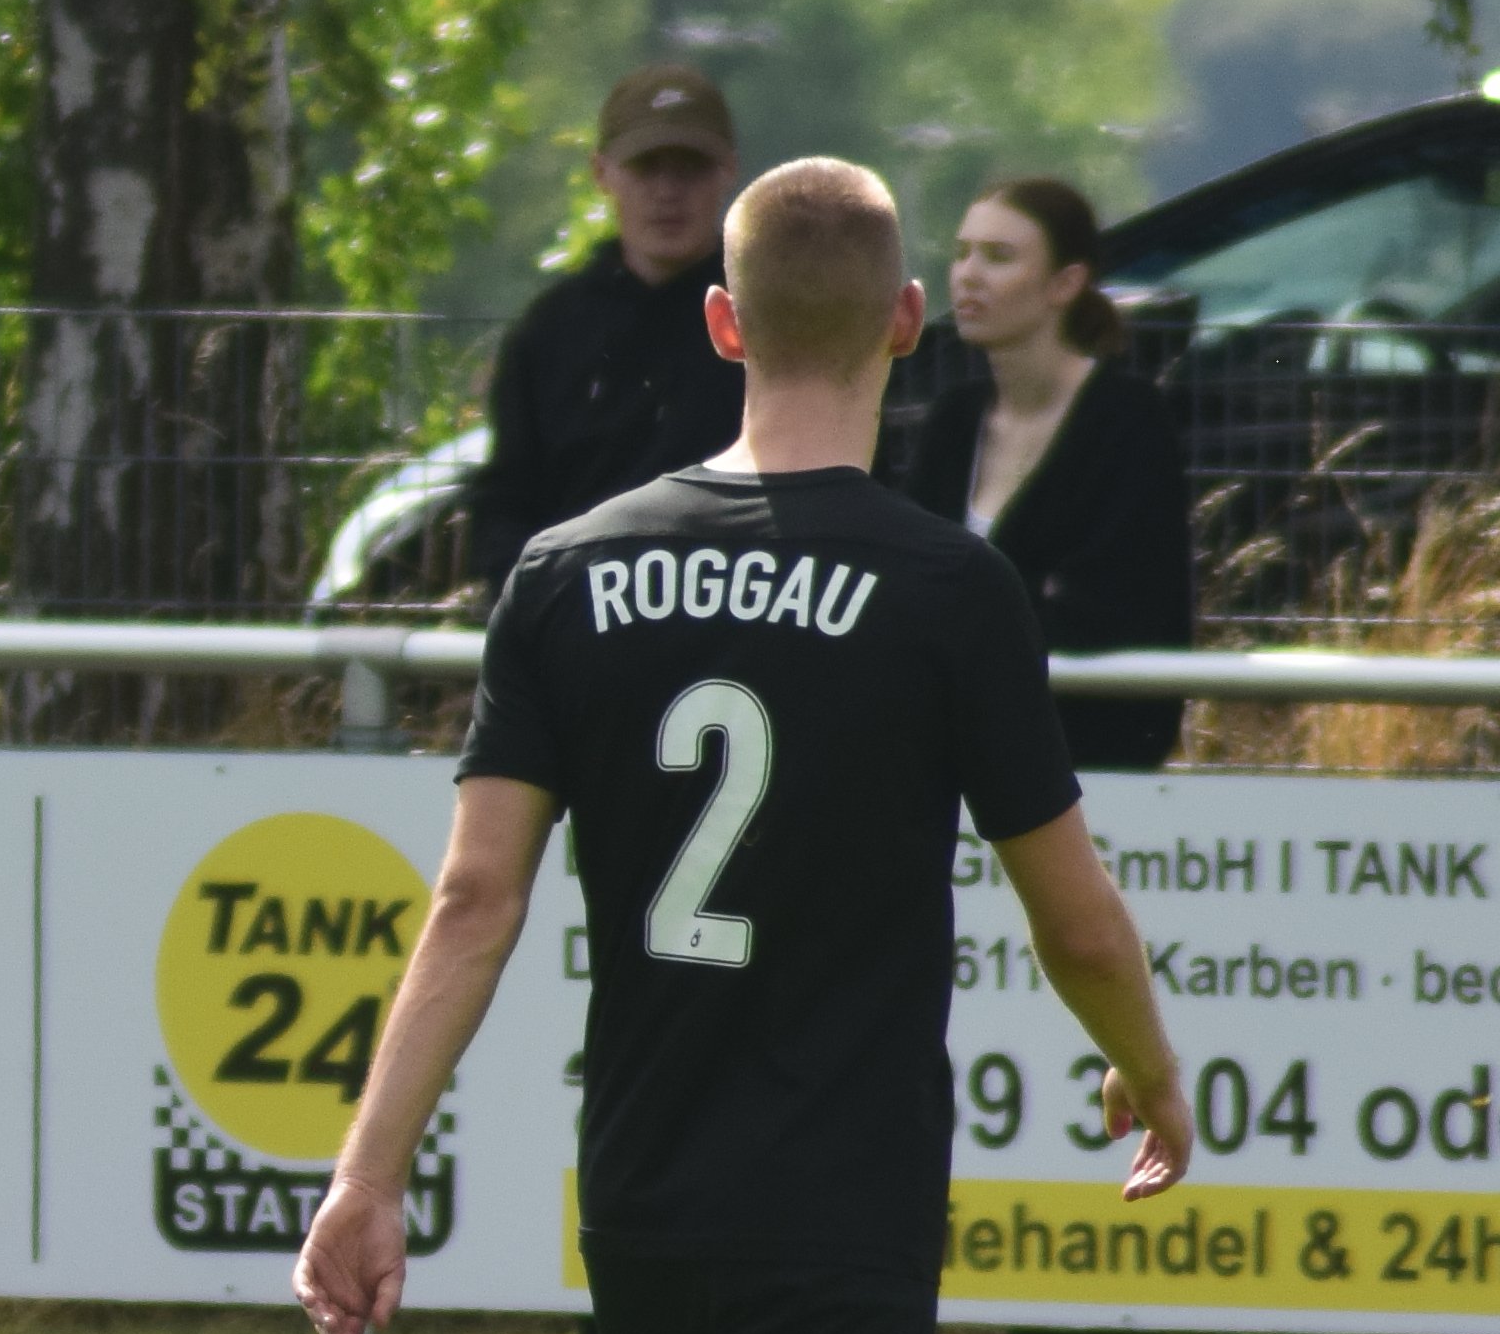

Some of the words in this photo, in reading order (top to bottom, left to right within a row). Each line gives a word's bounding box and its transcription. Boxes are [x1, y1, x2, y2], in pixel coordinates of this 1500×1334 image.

[588, 548, 879, 636] ROGGAU
[645, 679, 772, 967] 2
[1090, 834, 1257, 892] mbH
[1315, 839, 1489, 899] TANK
[200, 881, 412, 957] TANK
[1144, 942, 1358, 1000] Karben
[212, 972, 382, 1105] 24
[1357, 1064, 1491, 1160] od
[174, 1183, 433, 1235] STATN
[950, 1201, 1267, 1279] iehandel
[1299, 1209, 1353, 1280] &
